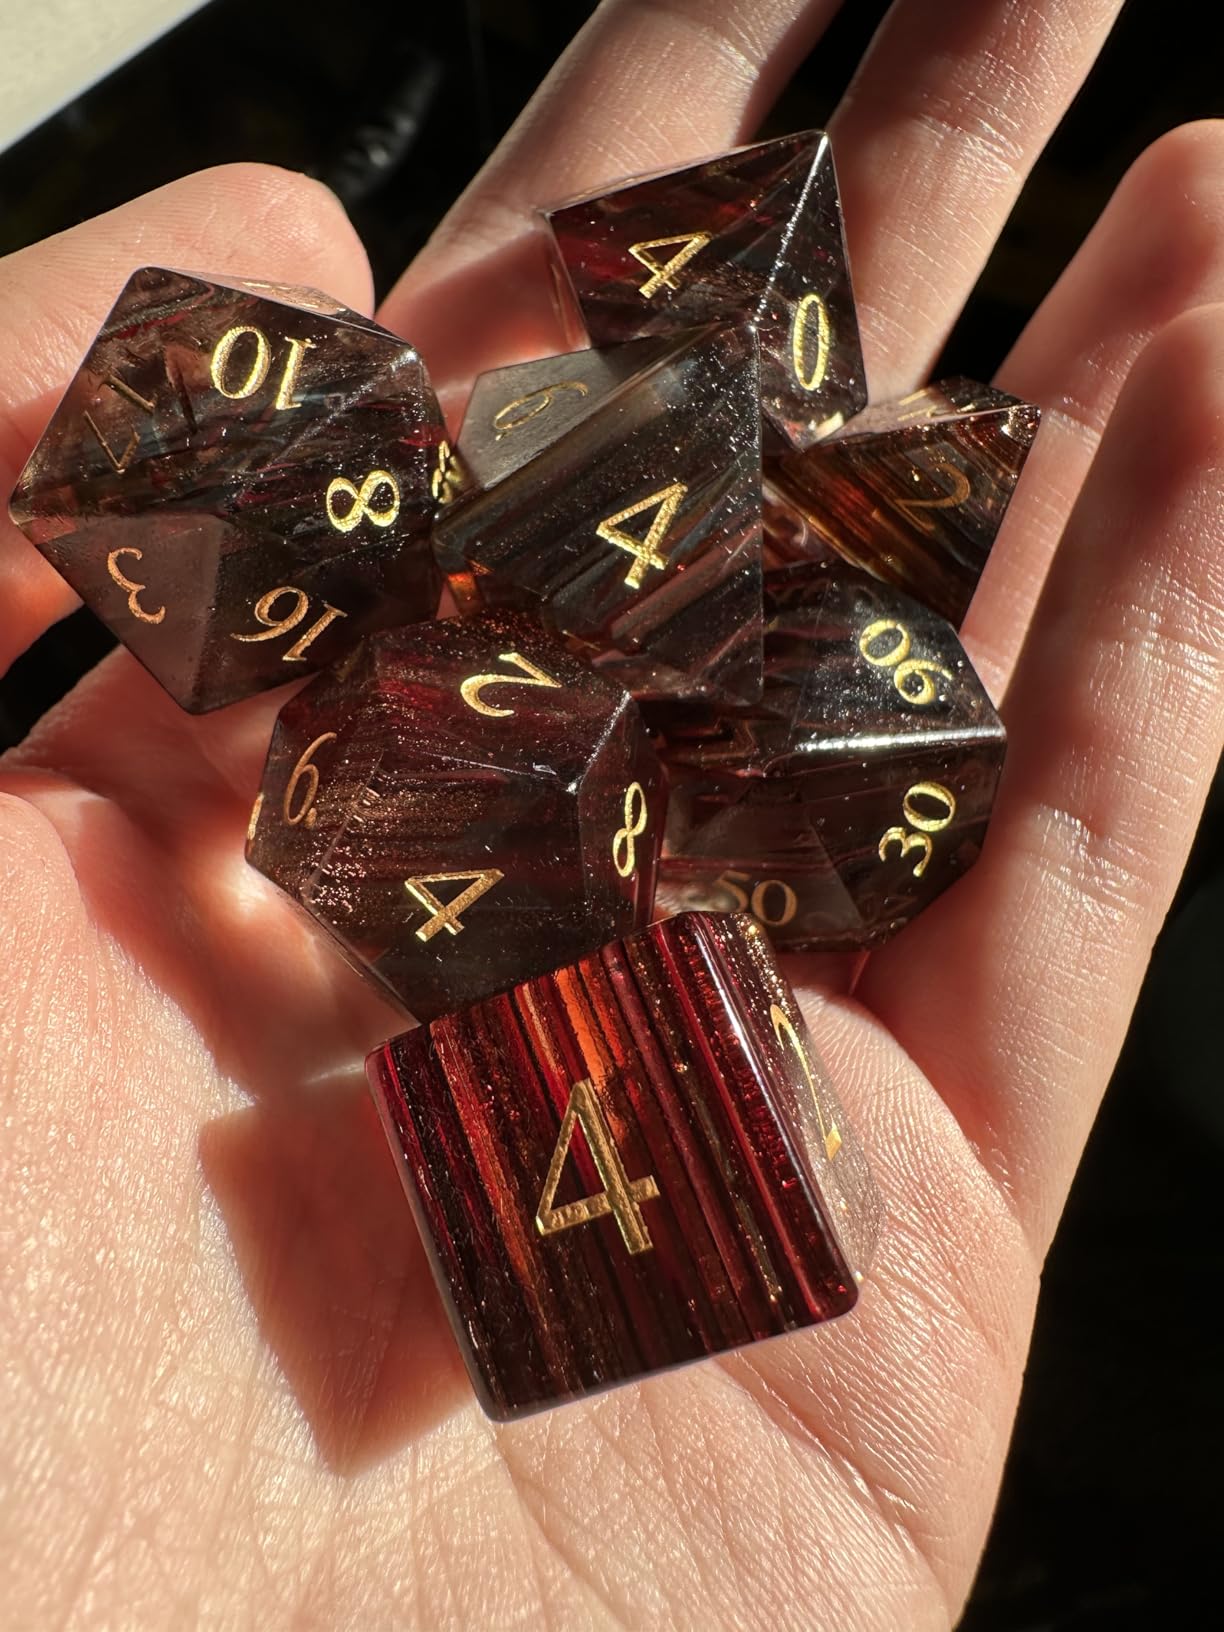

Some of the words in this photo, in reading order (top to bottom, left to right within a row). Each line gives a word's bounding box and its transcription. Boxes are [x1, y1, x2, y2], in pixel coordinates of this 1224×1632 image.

[628, 231, 712, 300] 4
[210, 326, 316, 411] 10
[326, 469, 400, 533] 8
[596, 482, 689, 590] 4
[107, 546, 166, 625] 3
[230, 586, 348, 662] 16
[612, 781, 648, 878] 8
[878, 781, 957, 878] 30
[404, 868, 505, 943] 4
[535, 1078, 661, 1256] 4
